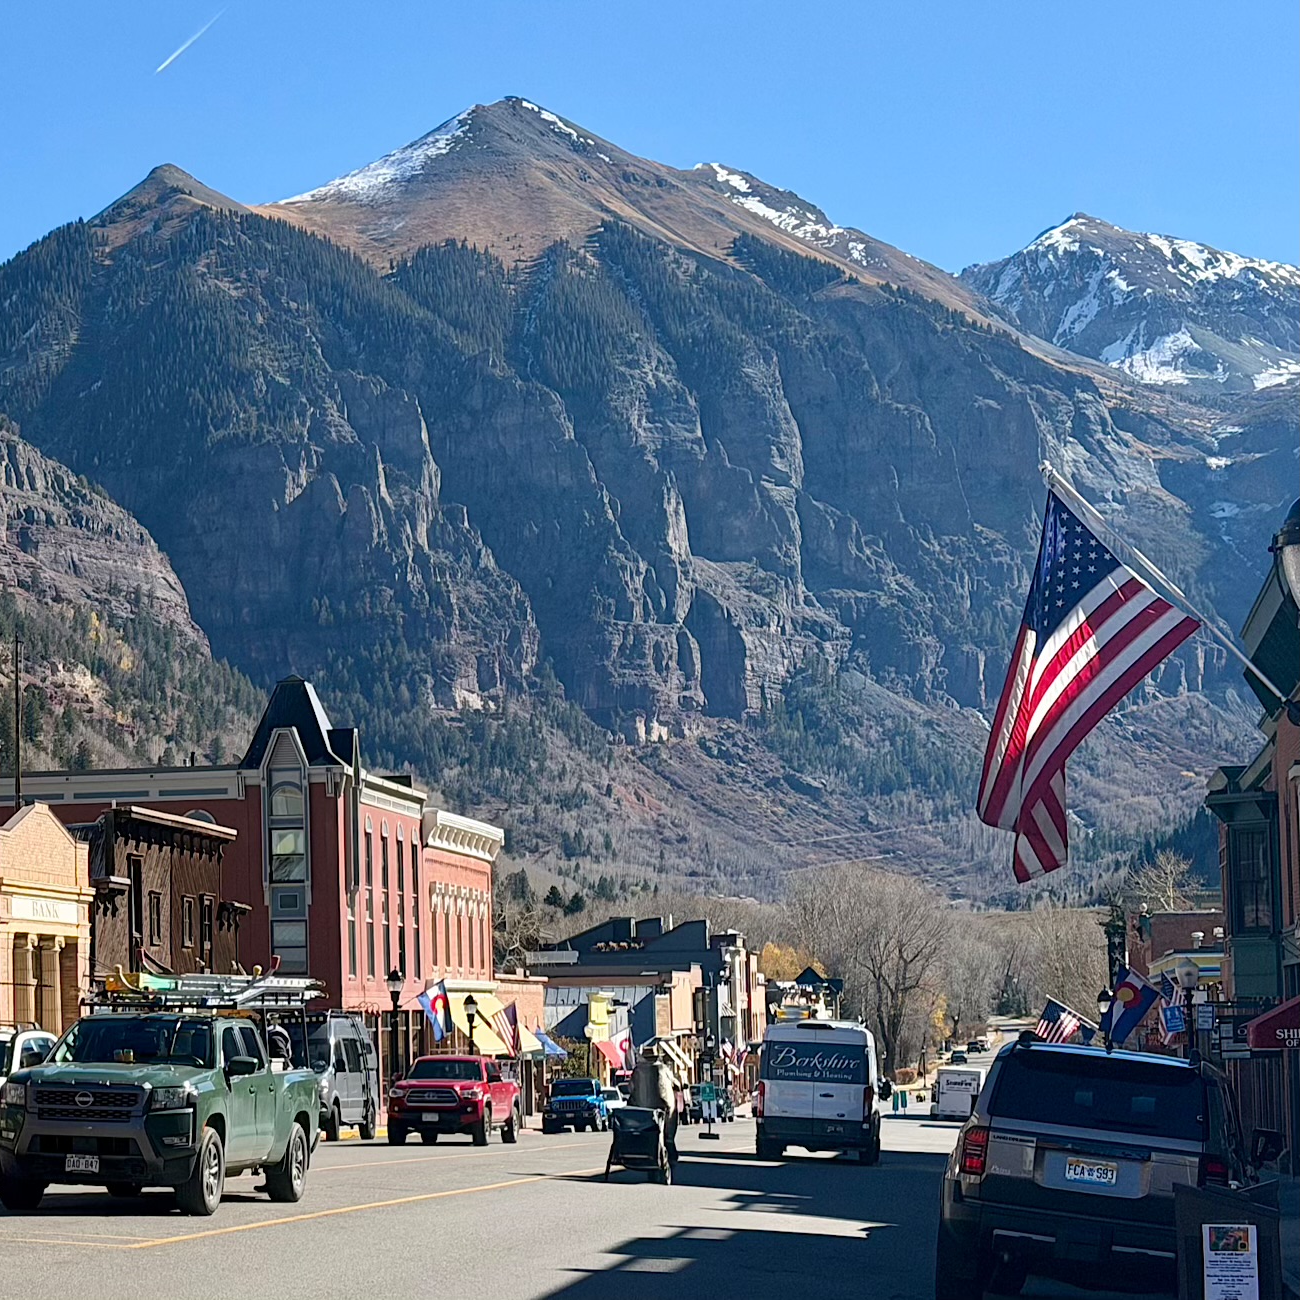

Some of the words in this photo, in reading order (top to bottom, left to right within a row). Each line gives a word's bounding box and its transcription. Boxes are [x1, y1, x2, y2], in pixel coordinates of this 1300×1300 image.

[32, 901, 59, 919] BANK
[770, 1045, 860, 1071] Berkshire
[776, 1069, 812, 1078] Plumbing
[822, 1070, 853, 1080] Heating
[1067, 1163, 1085, 1177] FCA
